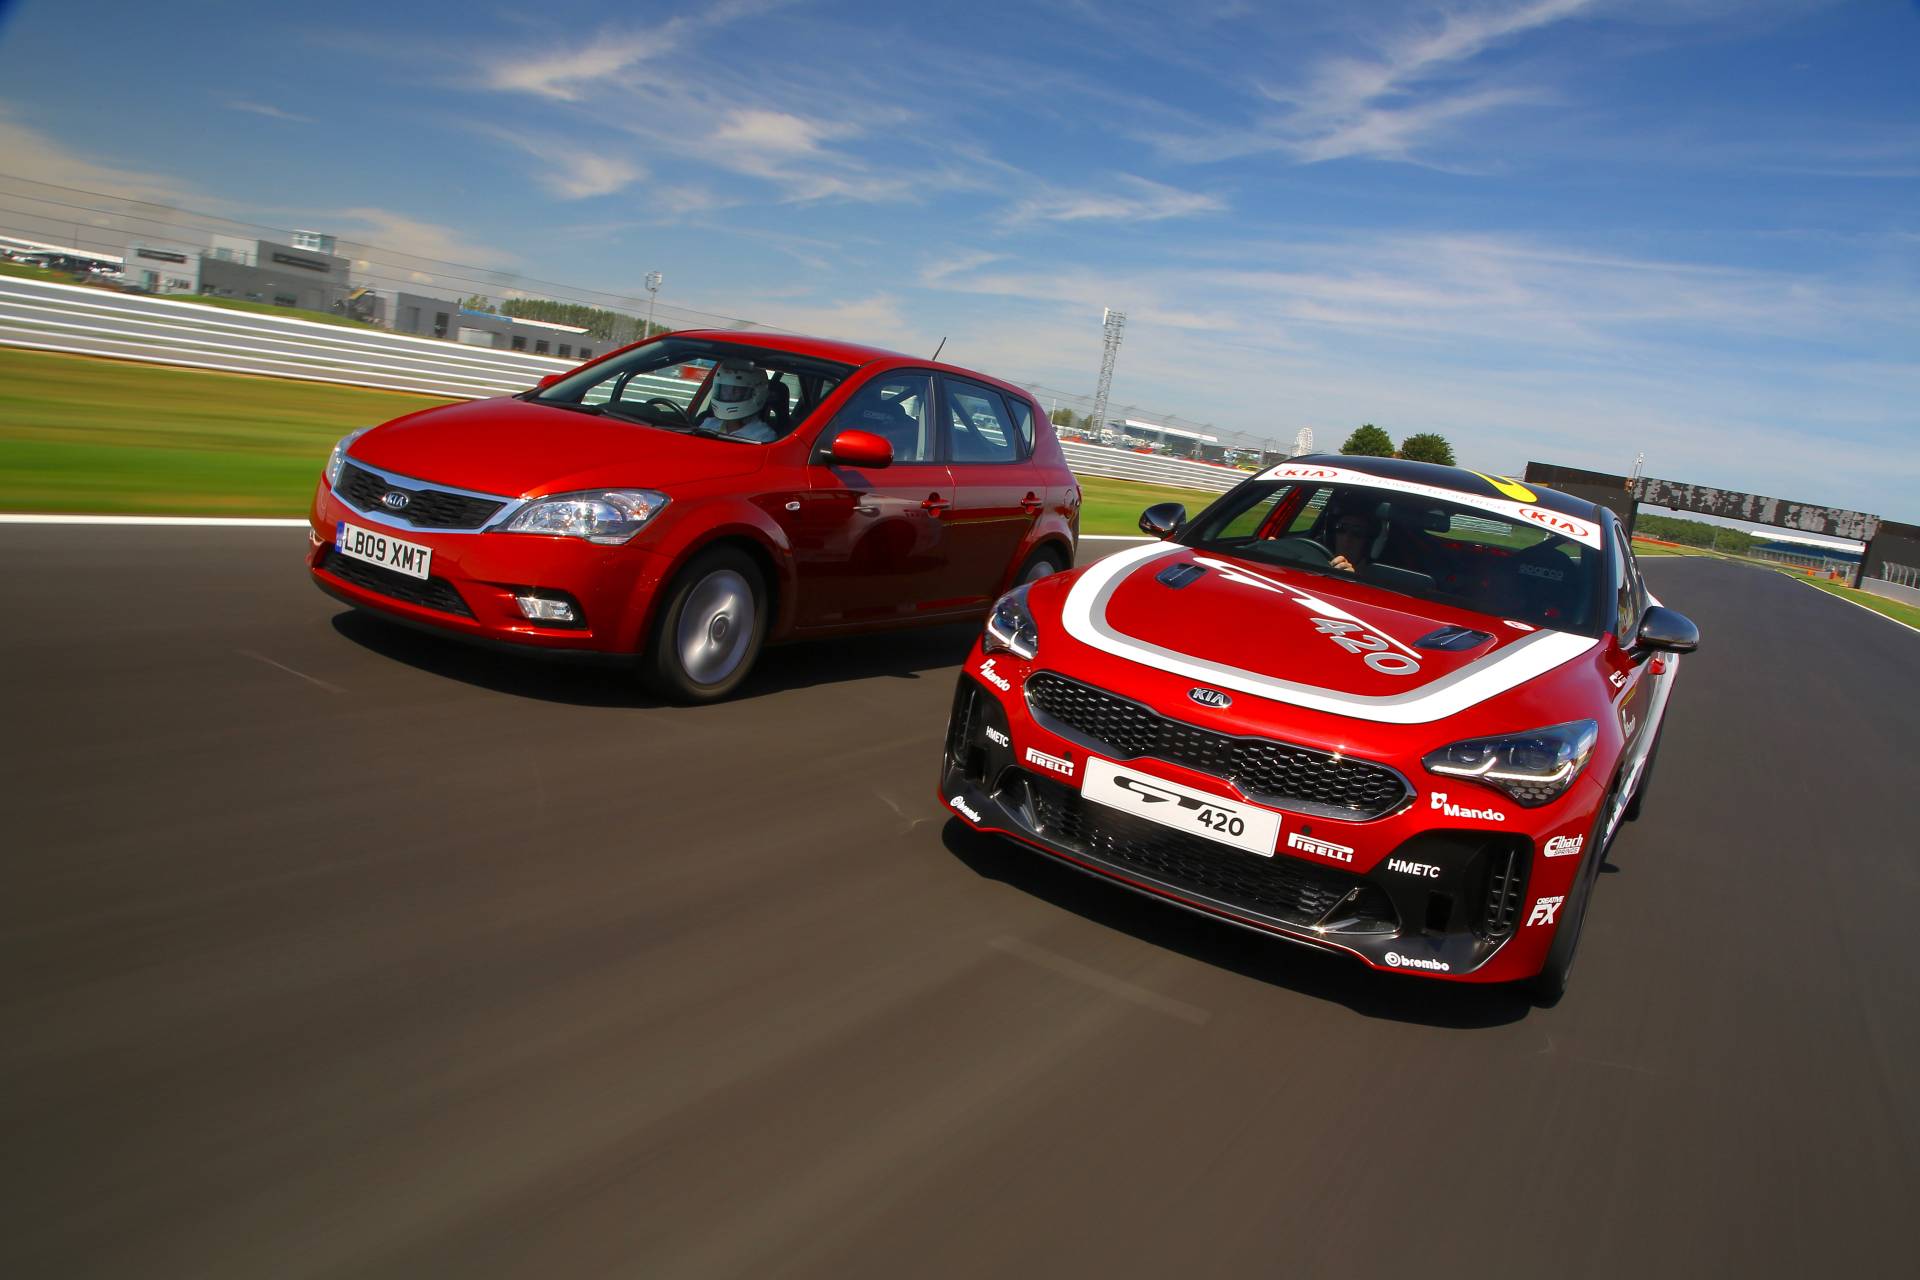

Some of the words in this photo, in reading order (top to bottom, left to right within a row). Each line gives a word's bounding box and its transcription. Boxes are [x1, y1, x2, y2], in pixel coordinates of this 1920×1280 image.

[1284, 469, 1325, 478] KIA
[387, 494, 403, 507] KIA
[1530, 511, 1576, 533] KIA
[344, 527, 387, 561] LB09
[390, 541, 427, 573] XMT
[1310, 617, 1421, 676] 420
[980, 667, 1011, 692] Mando
[1193, 687, 1226, 706] KIA
[985, 725, 1009, 748] HMETC
[1025, 747, 1075, 777] PIRELLI
[1197, 809, 1246, 837] 420
[1443, 803, 1506, 822] Mando
[1287, 832, 1355, 863] PIRELLI
[1387, 858, 1441, 879] HMETC
[1526, 903, 1562, 927] FX
[1401, 955, 1450, 971] brembo
